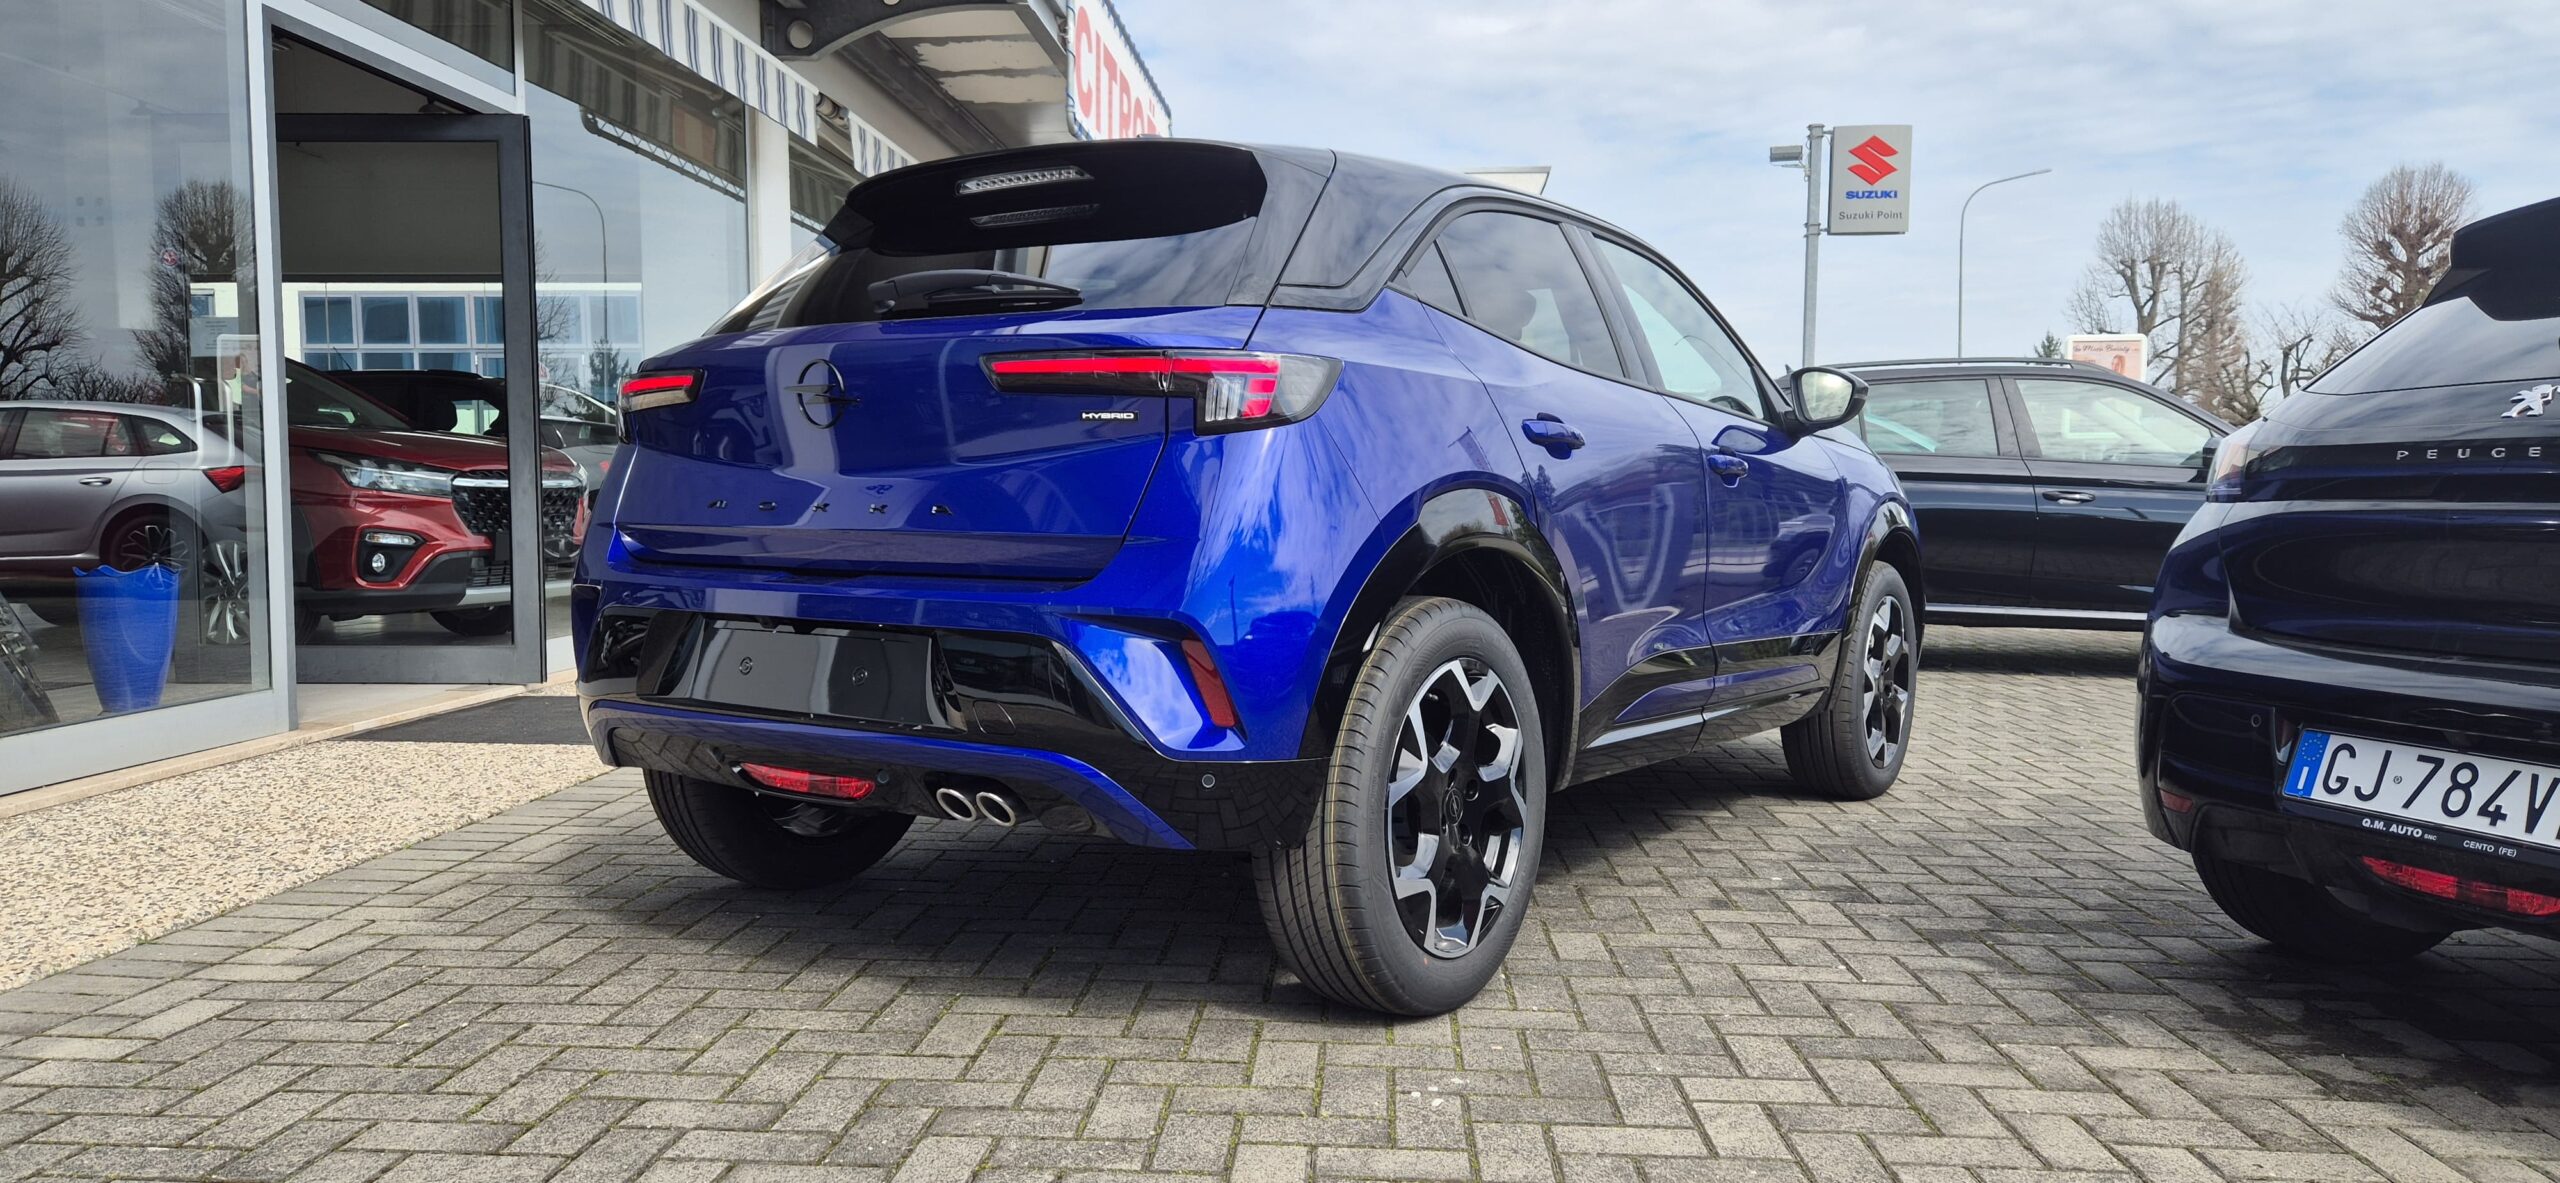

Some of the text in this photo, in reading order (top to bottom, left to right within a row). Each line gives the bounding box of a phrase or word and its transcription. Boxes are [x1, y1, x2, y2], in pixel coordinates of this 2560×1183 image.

[1845, 190, 1898, 199] SUZUKI
[1839, 211, 1903, 220] Suzuki Point
[2401, 755, 2560, 840] 784V
[2361, 818, 2387, 831] Q.M.
[2389, 823, 2422, 838] AUTO
[2463, 839, 2517, 857] CENTO (FE)
